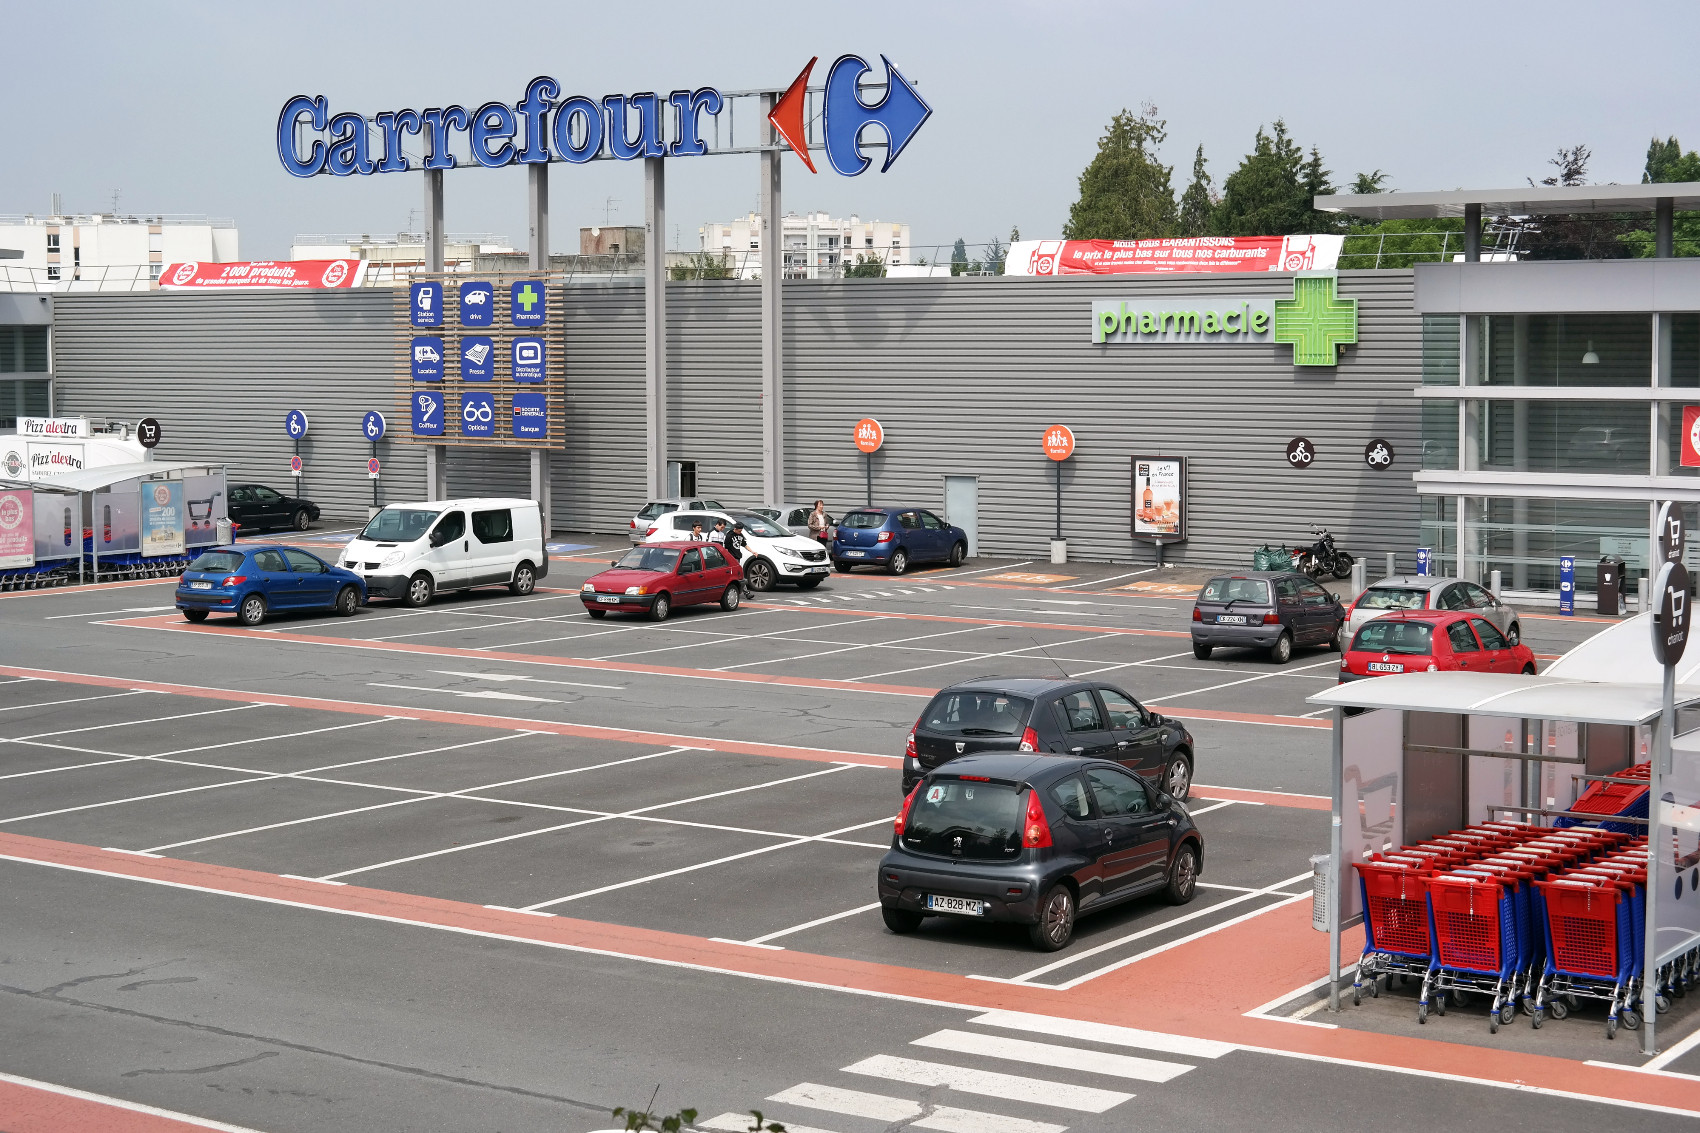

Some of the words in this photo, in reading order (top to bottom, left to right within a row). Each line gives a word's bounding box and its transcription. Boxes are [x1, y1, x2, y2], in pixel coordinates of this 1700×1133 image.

[277, 76, 724, 177] Carrefour
[1113, 240, 1136, 248] NOUS
[1162, 237, 1235, 247] GARANTISSONS
[1073, 250, 1081, 258] le
[1083, 250, 1102, 261] prix
[1104, 249, 1112, 258] le
[1113, 249, 1134, 260] plus
[1135, 248, 1152, 258] bas
[1154, 249, 1169, 258] sur
[1172, 248, 1194, 258] tous
[1194, 249, 1214, 258] nos
[249, 266, 296, 278] produits
[227, 278, 250, 286] marques
[1098, 301, 1269, 343] pharmacie
[24, 419, 77, 434] Pizz'alextra
[31, 450, 82, 470] Pizz'alextra
[162, 507, 175, 516] 200
[1667, 630, 1684, 646] chariot
[931, 789, 939, 800] A
[935, 898, 977, 911] AZ-828-MZ
